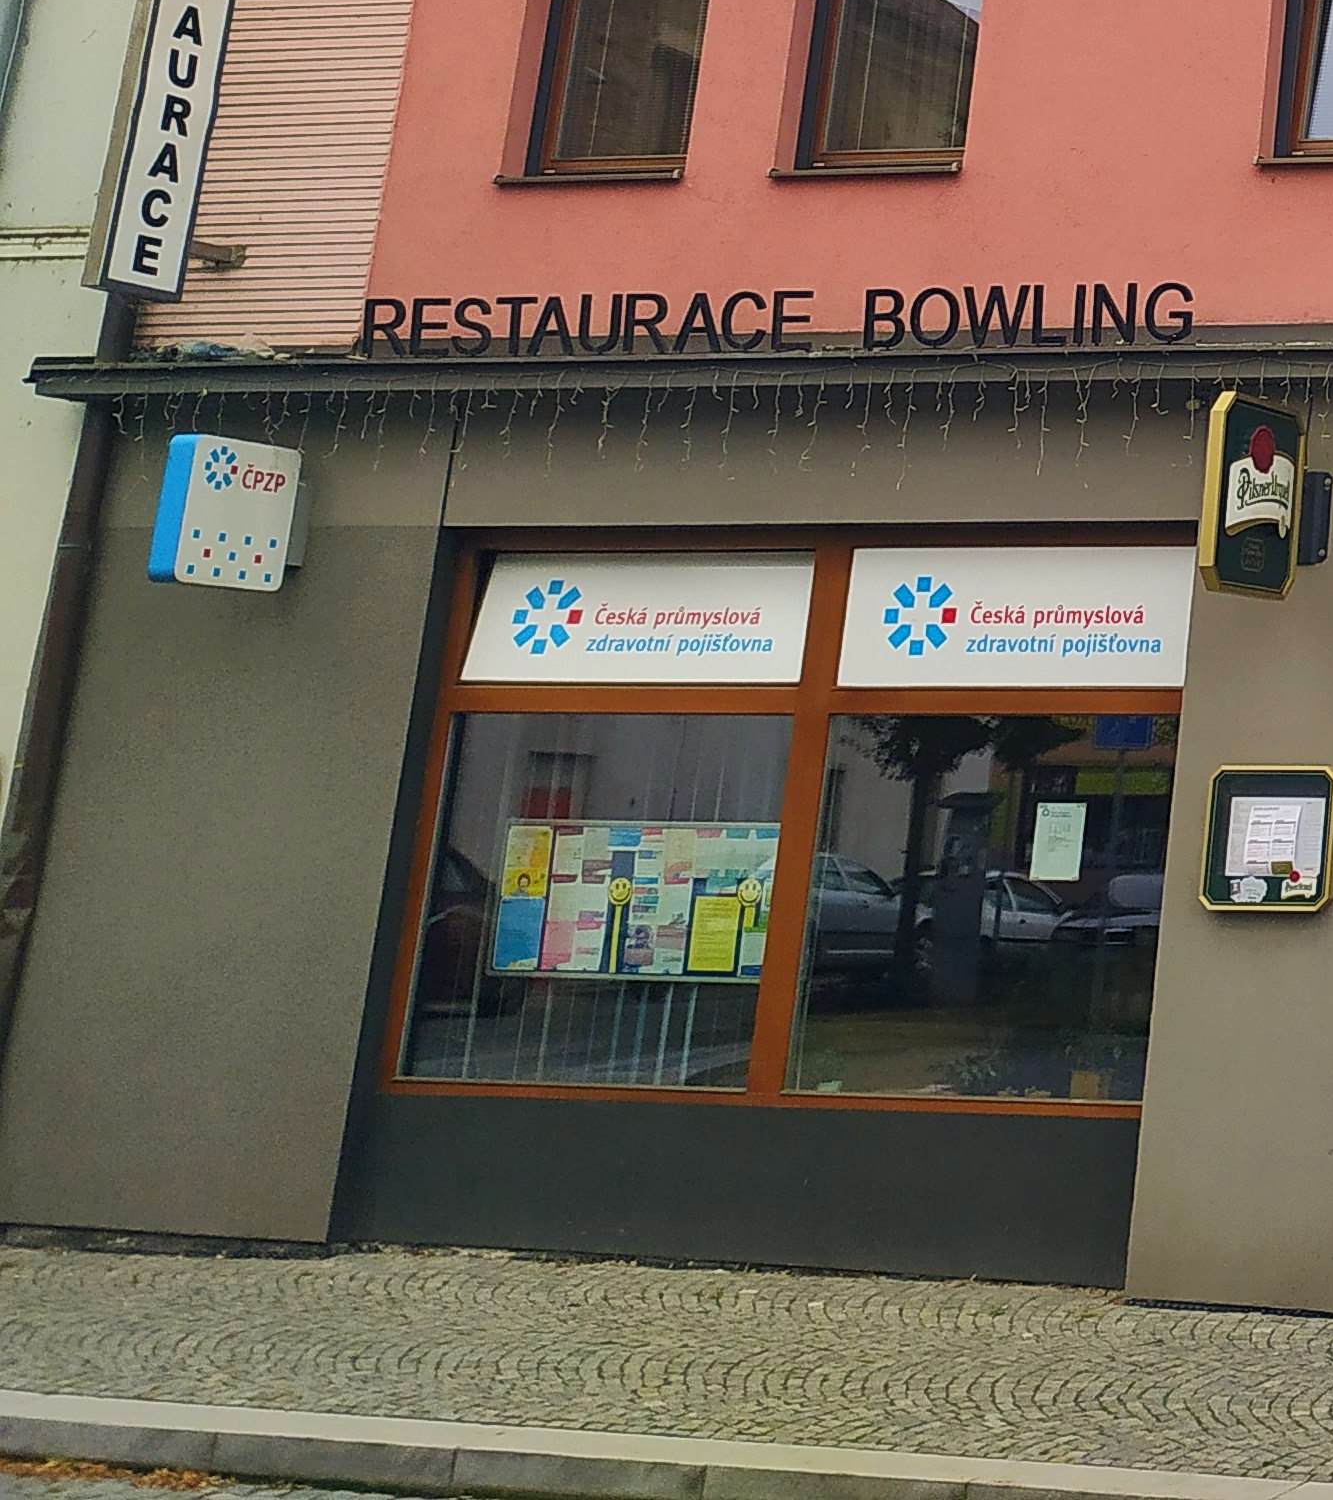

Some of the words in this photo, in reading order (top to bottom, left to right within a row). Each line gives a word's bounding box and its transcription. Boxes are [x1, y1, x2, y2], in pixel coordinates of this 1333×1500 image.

[361, 291, 813, 357] RESTAURACE
[864, 282, 1195, 351] BOWLING
[241, 463, 286, 493] ČPZP
[594, 603, 648, 625] Česká
[653, 606, 761, 629] průmyslová
[970, 601, 1025, 624] Česká
[1033, 604, 1144, 629] průmyslová
[586, 633, 674, 652] zdravotní
[676, 633, 773, 656] pojišťovna
[965, 633, 1056, 653] zdravotní
[1062, 633, 1162, 657] pojišťovna
